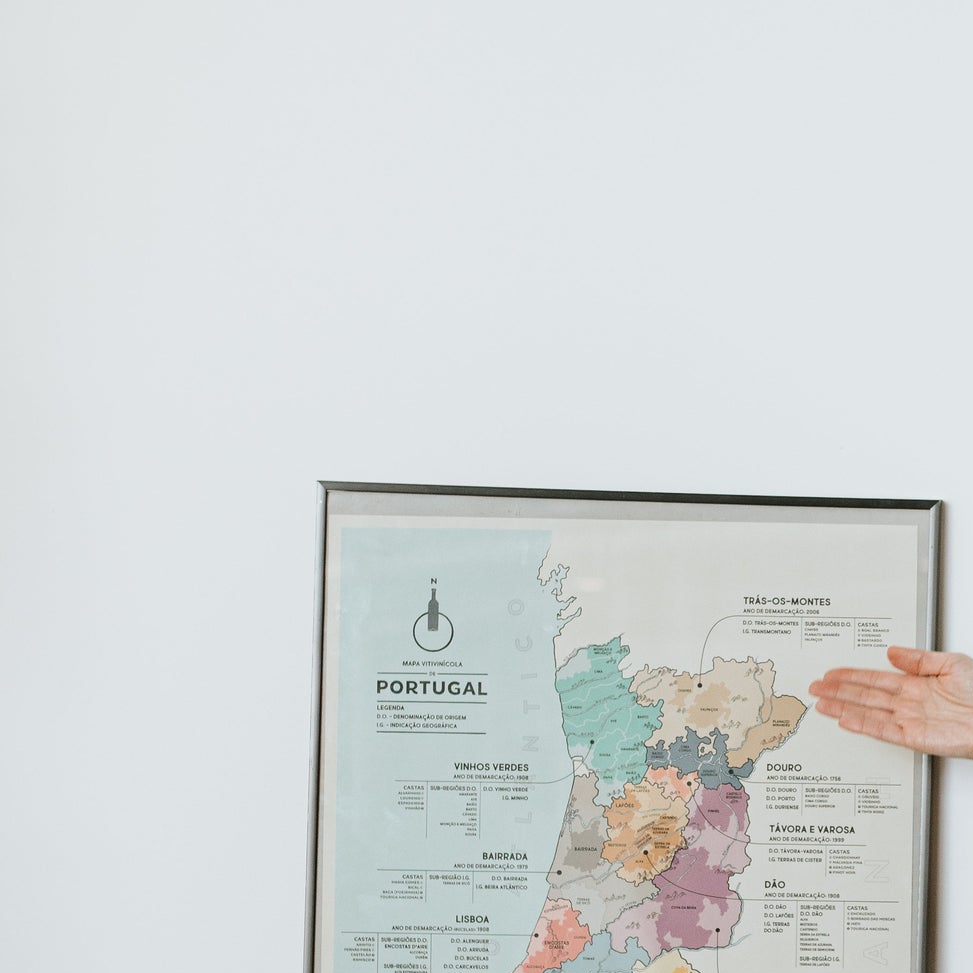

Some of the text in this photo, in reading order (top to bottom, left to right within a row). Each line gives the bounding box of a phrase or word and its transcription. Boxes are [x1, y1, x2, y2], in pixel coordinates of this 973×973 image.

[743, 595, 831, 606] TRÁS-OS-MONTES
[377, 680, 488, 696] PORTUGAL
[390, 722, 420, 730] INDICAÇÃO
[454, 763, 529, 772] VINHOS VERDES
[766, 764, 802, 772] DOURO
[769, 822, 855, 834] TÁVORA E VAROSA
[482, 852, 528, 861] BAIRRADA
[764, 879, 785, 889] DÃO
[456, 915, 490, 923] LISBOA
